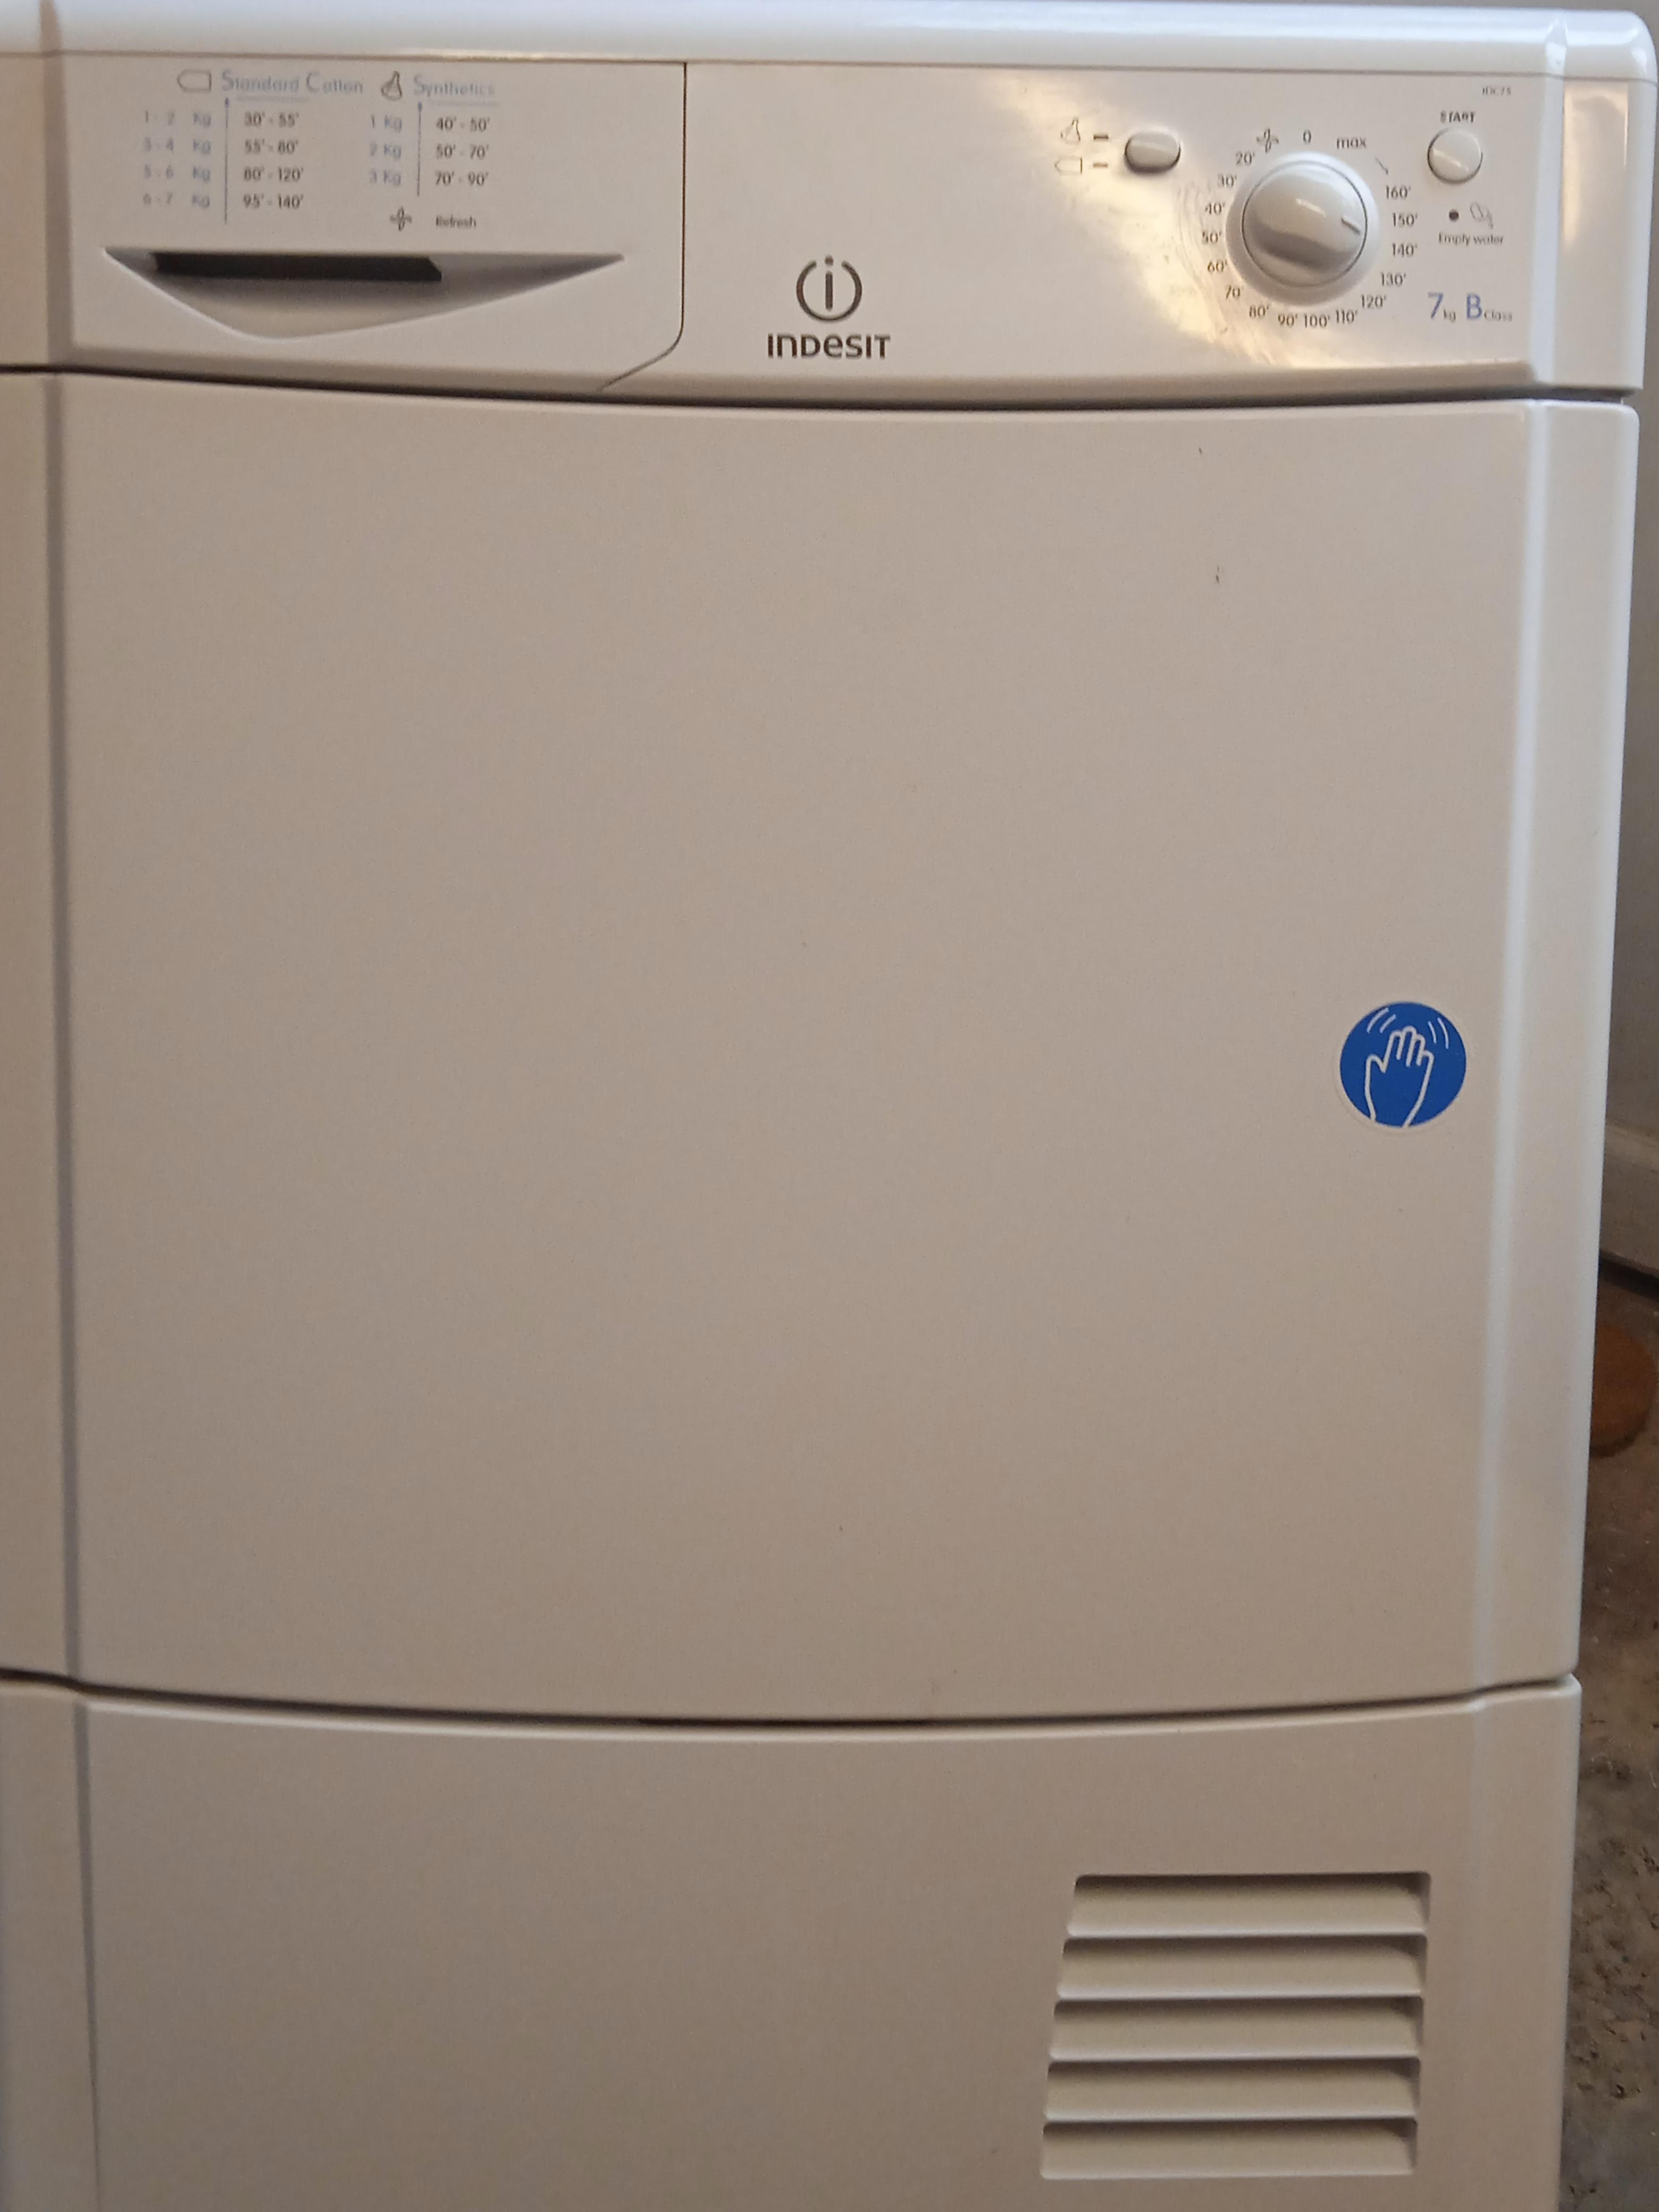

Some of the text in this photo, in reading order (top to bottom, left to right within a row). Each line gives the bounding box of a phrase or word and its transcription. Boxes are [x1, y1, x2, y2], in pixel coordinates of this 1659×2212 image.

[221, 69, 364, 94] Standard Cotton
[413, 73, 496, 97] Synthetics
[1440, 111, 1476, 123] START
[1302, 129, 1312, 145] 0
[1336, 137, 1367, 150] max
[435, 215, 476, 229] Refresh
[1438, 233, 1504, 247] Empty water
[1428, 292, 1513, 323] 7 kg B Class
